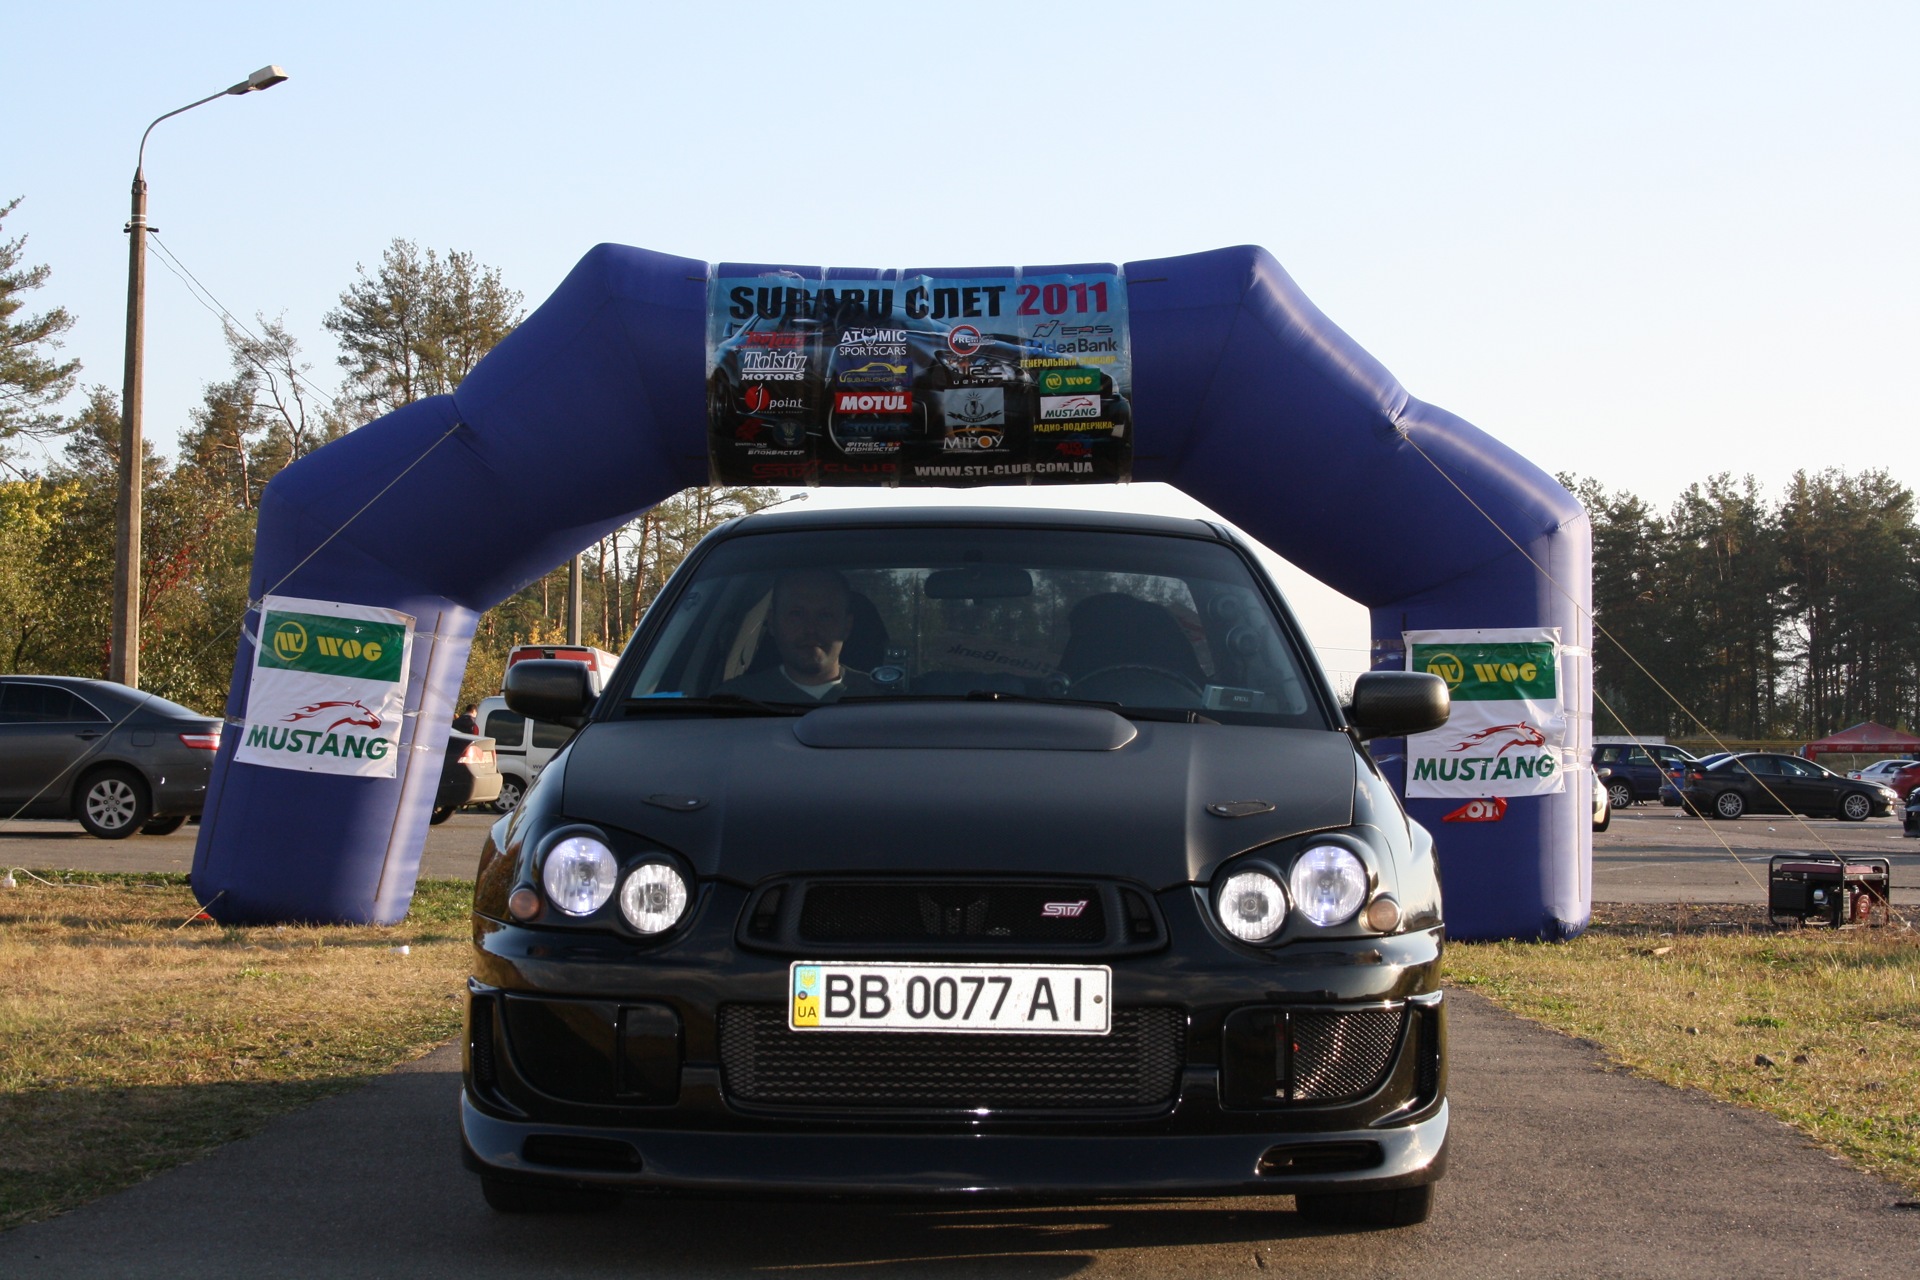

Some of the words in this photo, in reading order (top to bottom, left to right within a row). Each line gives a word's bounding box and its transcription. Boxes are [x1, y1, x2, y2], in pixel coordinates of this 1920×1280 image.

[729, 285, 893, 320] SUBARU
[905, 285, 1005, 319] СЛЕТ
[1016, 281, 1108, 315] 2011
[839, 346, 907, 356] SPORTSCARS
[741, 373, 805, 381] MOTORS
[769, 397, 804, 410] point
[839, 395, 908, 411] MOTUL
[1045, 408, 1097, 418] MUSTANG
[823, 463, 897, 473] CLUB
[914, 461, 1094, 477] WWW.STI-CLUB.COM.UA
[316, 635, 382, 661] WOG
[1472, 662, 1537, 682] WOG
[245, 724, 389, 760] MUSTANG
[1412, 754, 1555, 781] MUSTANG
[797, 1006, 817, 1018] UA
[825, 974, 892, 1019] BB
[905, 975, 1012, 1020] 0077
